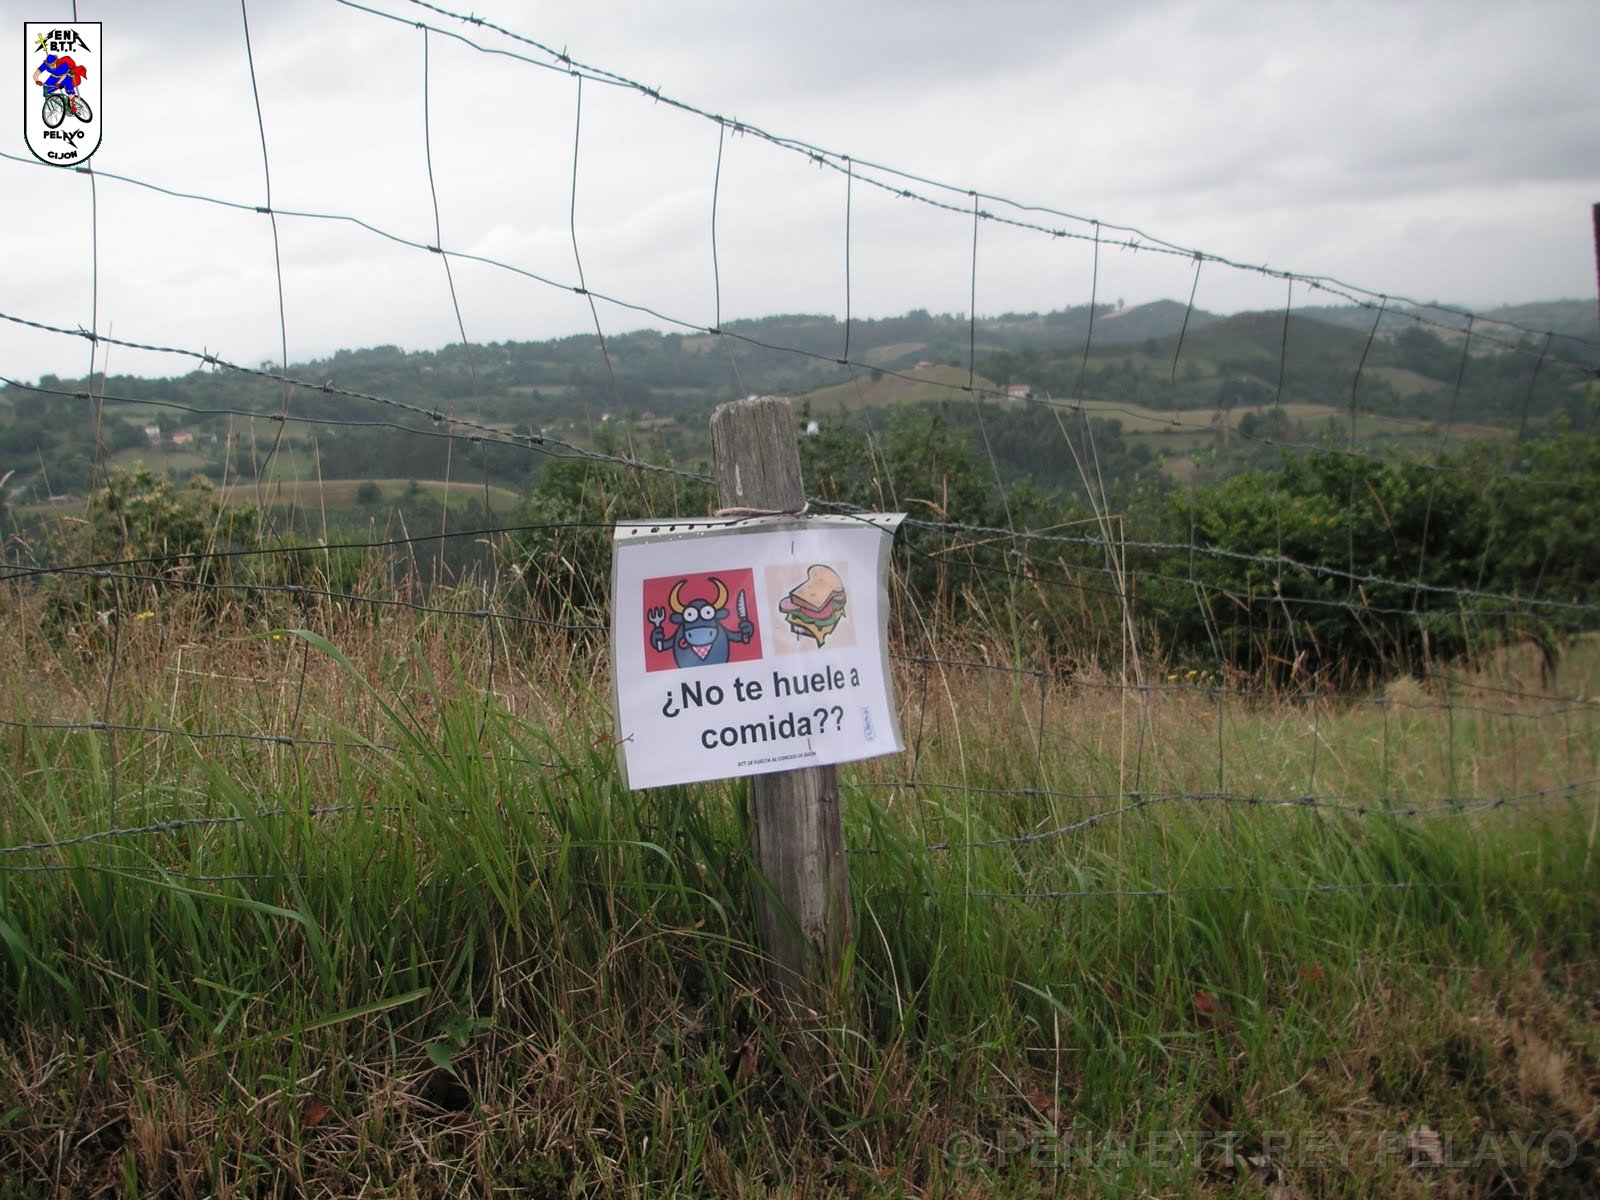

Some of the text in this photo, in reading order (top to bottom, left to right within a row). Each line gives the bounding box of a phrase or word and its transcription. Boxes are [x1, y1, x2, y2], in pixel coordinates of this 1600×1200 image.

[661, 665, 860, 718] ¿No te huele a
[701, 705, 844, 749] comida??
